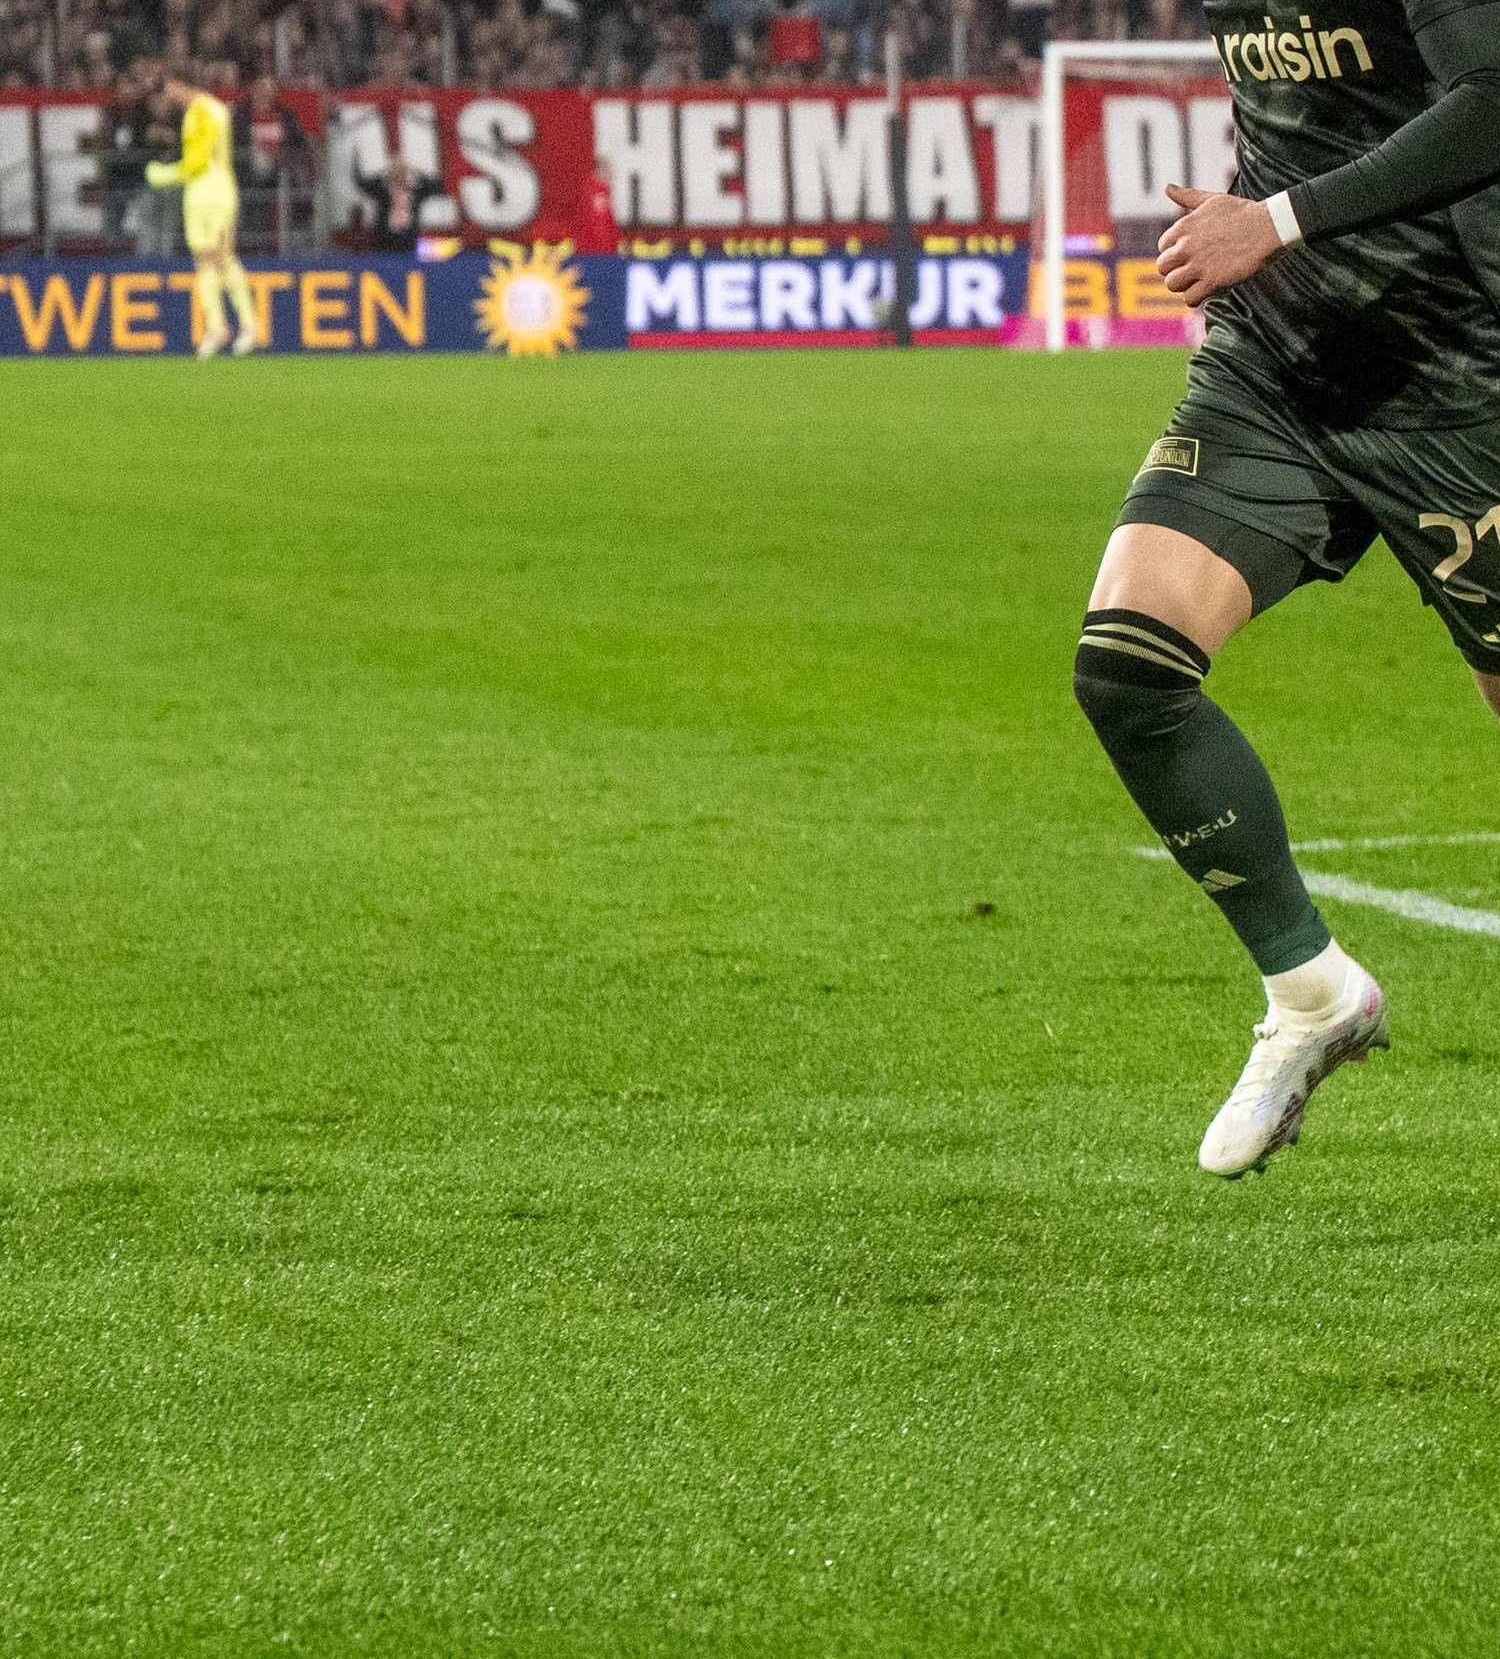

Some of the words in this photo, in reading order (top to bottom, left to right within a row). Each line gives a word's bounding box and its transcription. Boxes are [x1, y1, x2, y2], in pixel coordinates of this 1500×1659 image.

[1225, 16, 1374, 83] raisin
[592, 98, 1042, 225] HEIMAT
[0, 270, 425, 351] WETTEN
